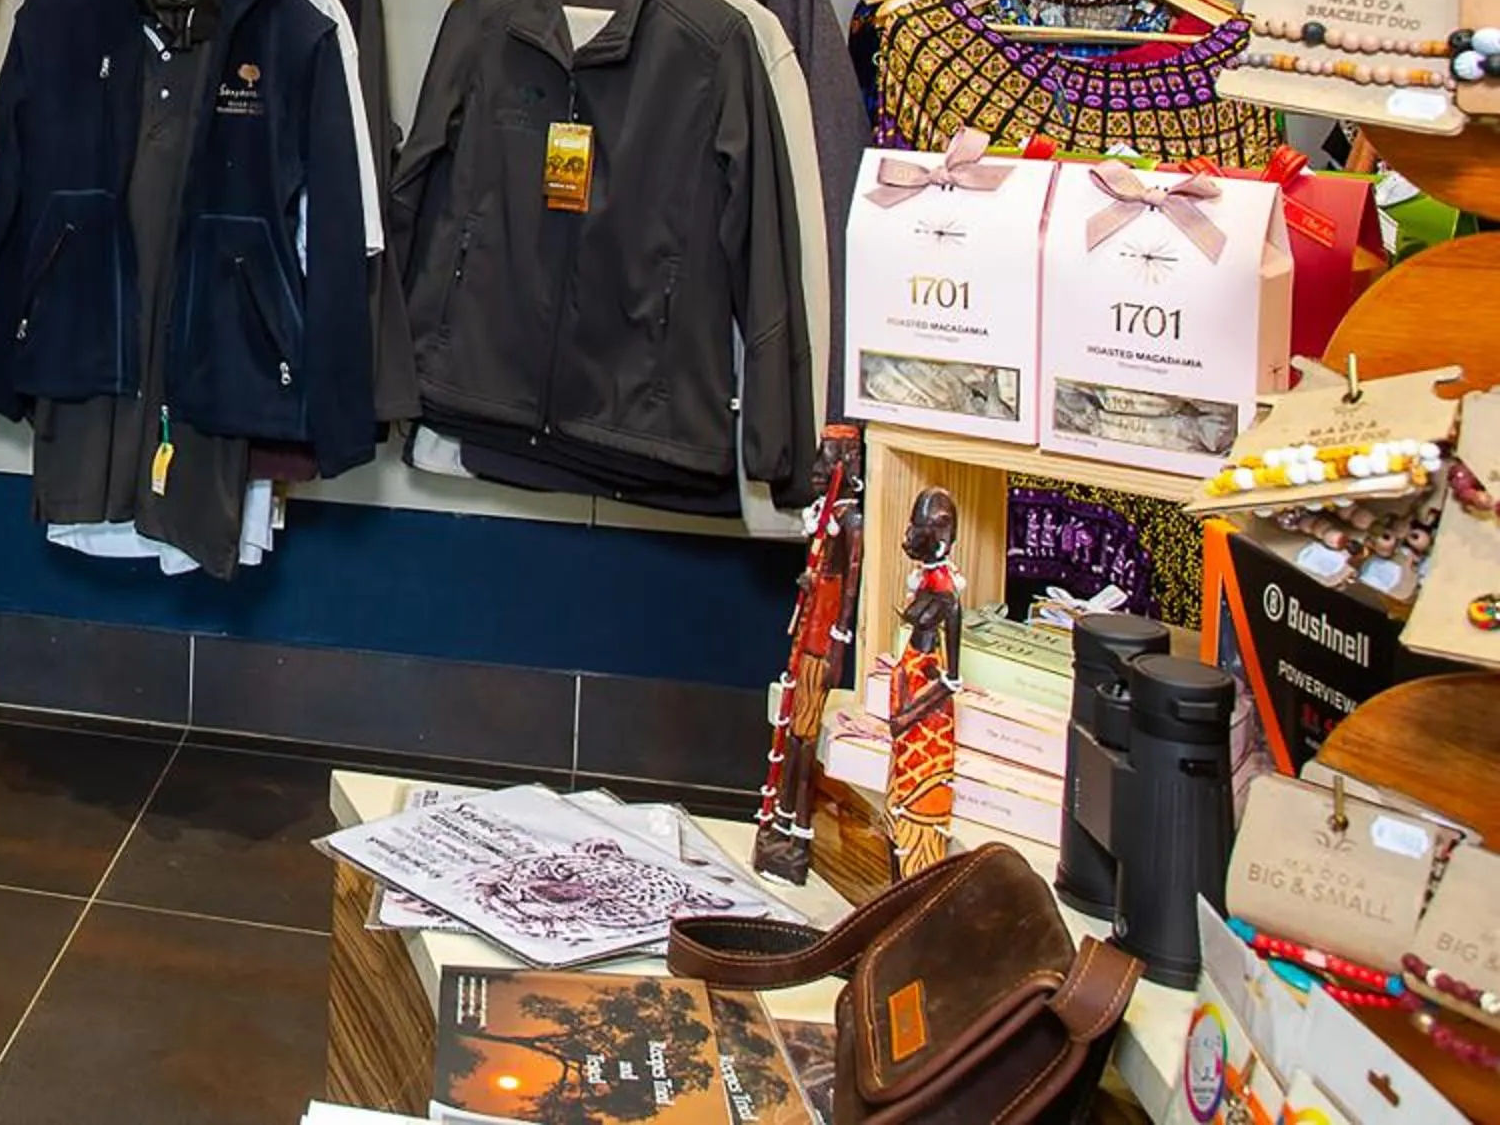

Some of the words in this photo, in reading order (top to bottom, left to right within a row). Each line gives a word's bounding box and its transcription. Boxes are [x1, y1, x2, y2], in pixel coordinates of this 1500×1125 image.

[1306, 4, 1386, 26] BRACELET
[1388, 16, 1422, 30] DUO
[908, 275, 969, 309] 1701
[1110, 302, 1182, 339] 1701
[1136, 352, 1203, 369] MACADAMIA
[1287, 596, 1370, 668] Bushnell
[1278, 659, 1358, 714] POWERVIEW
[1248, 862, 1286, 889] BIG
[1290, 877, 1306, 897] &
[1311, 882, 1393, 923] SMALL
[1436, 931, 1479, 963] BIG
[653, 1079, 675, 1106] Tried
